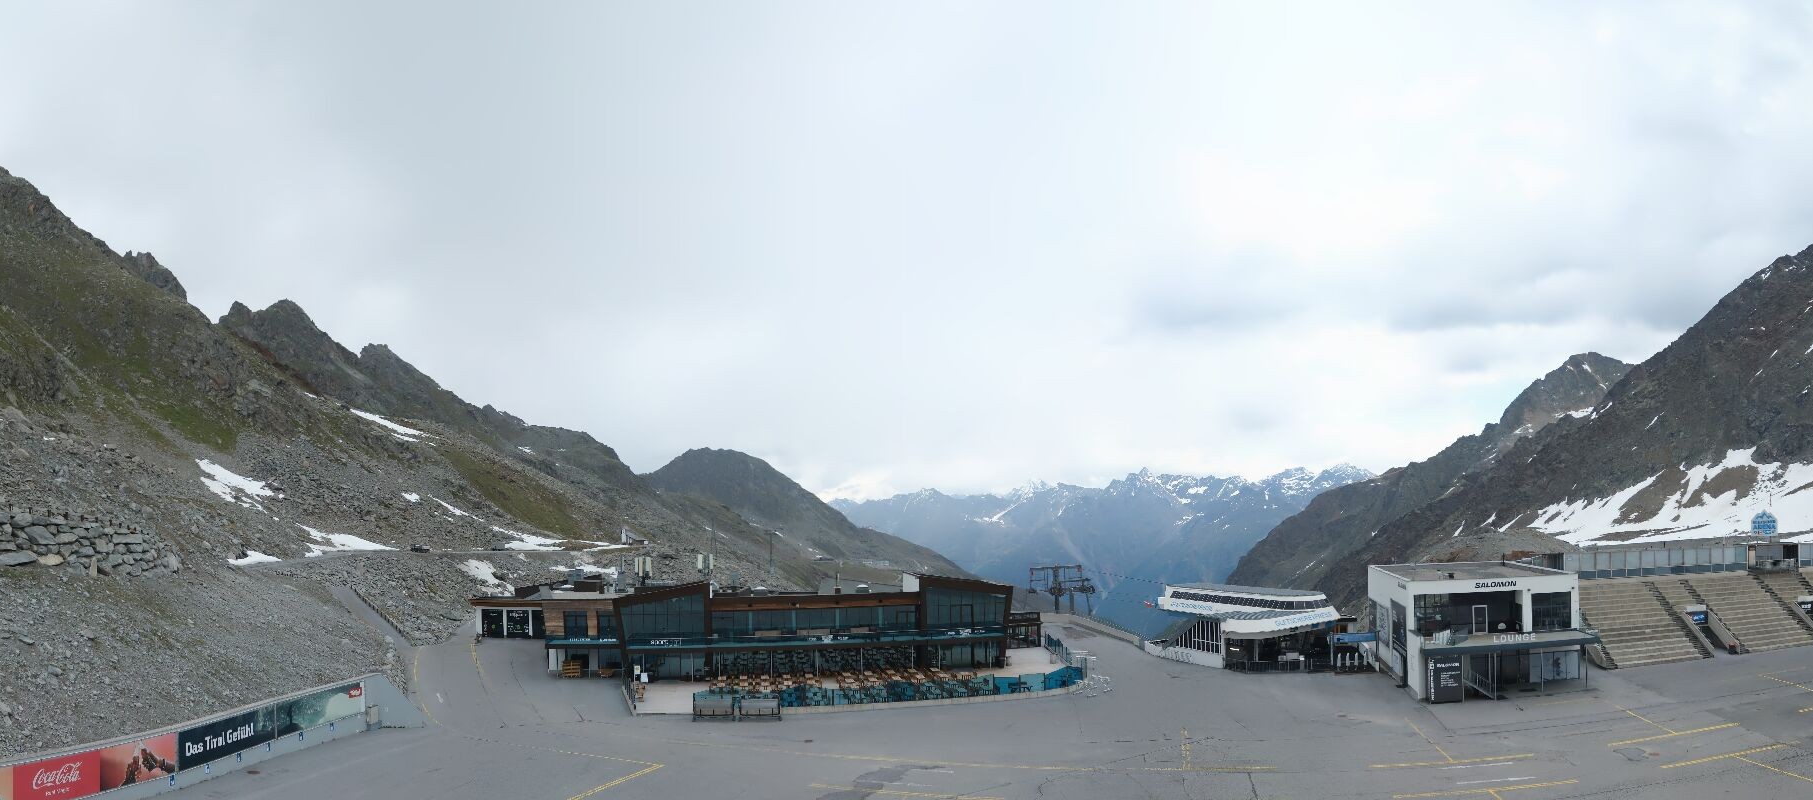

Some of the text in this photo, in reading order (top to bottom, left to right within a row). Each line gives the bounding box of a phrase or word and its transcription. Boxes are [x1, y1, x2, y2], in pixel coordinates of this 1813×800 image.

[1475, 581, 1517, 589] SALOMON
[1493, 633, 1536, 643] LOUNGE
[185, 722, 254, 756] Das Tirol Gefühl
